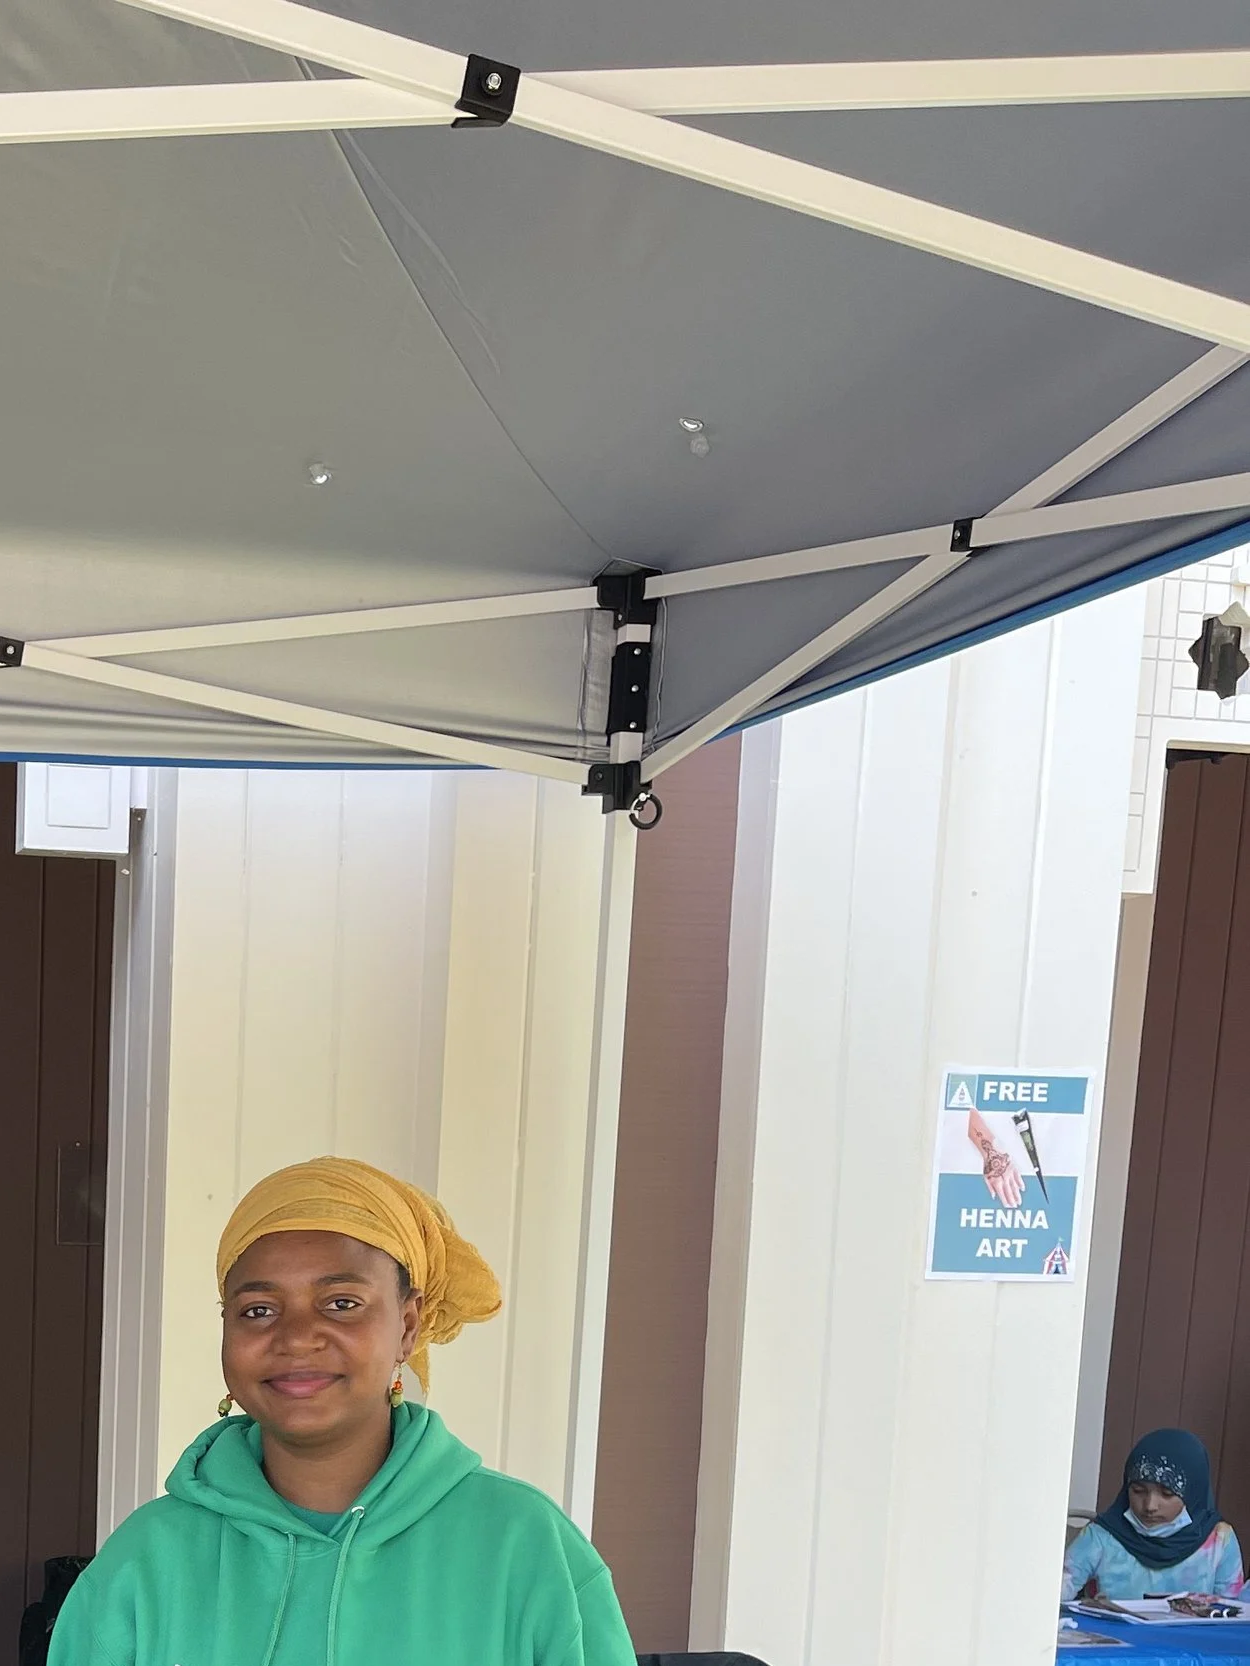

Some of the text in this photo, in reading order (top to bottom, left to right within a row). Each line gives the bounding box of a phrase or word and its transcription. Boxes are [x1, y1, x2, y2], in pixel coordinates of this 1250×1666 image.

[982, 1080, 1049, 1102] FREE
[959, 1208, 1049, 1229] HENNA
[975, 1238, 1028, 1258] ART
